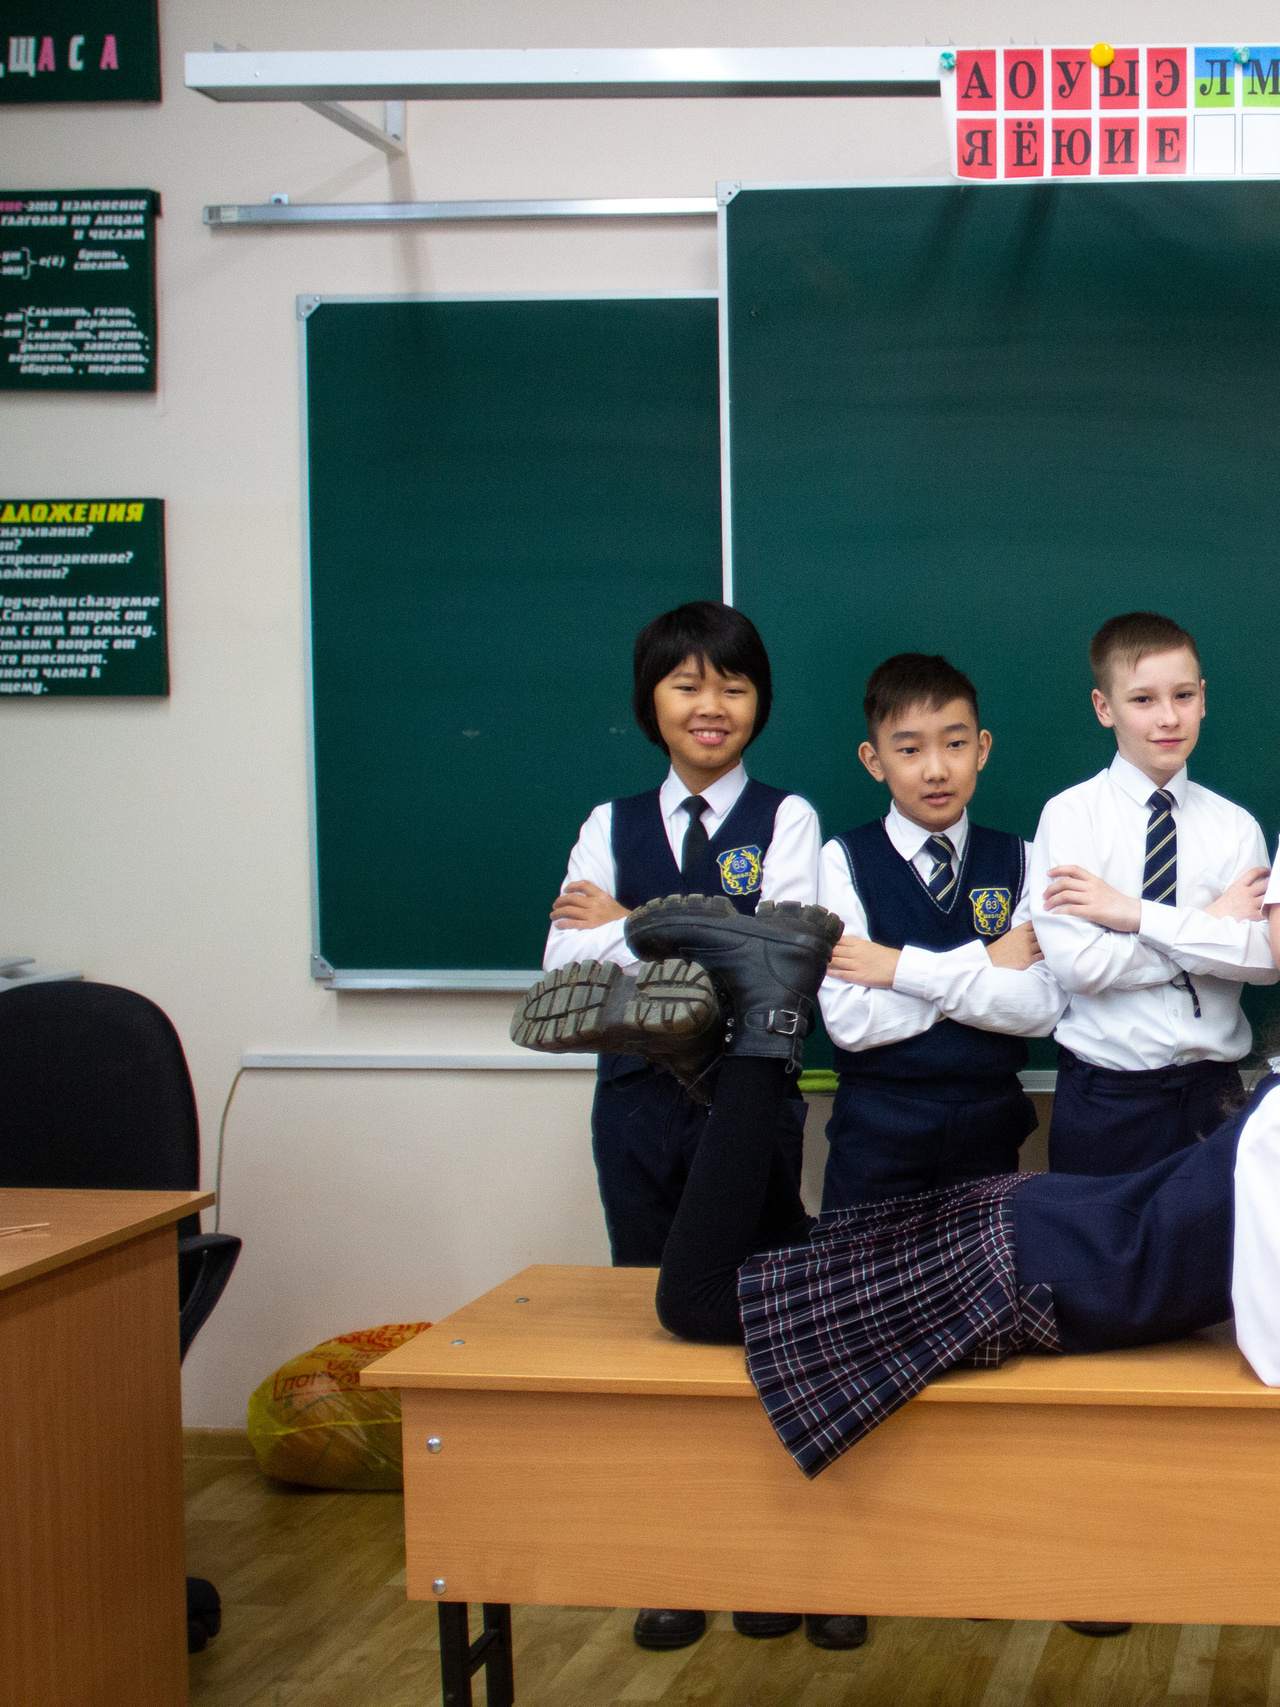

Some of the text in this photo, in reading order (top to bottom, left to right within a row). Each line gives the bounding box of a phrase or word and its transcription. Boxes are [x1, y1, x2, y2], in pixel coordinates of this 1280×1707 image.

[962, 61, 992, 99] А
[1008, 60, 1036, 99] О
[1056, 61, 1086, 98] У
[1101, 60, 1139, 97] Ы
[1155, 58, 1180, 97] Э
[1200, 58, 1230, 95] Л
[962, 130, 992, 166] Я
[1012, 121, 1037, 166] Ё
[1052, 129, 1091, 165] Ю
[1104, 129, 1135, 164] И
[1155, 128, 1180, 163] Е
[0, 503, 144, 523] ДЛОЖЕНИЯ
[0, 525, 94, 538] казывания?
[67, 610, 121, 623] вопрос
[124, 610, 148, 622] от
[33, 625, 65, 636] ним
[70, 625, 90, 636] по
[0, 639, 137, 652] тавим вопрос от
